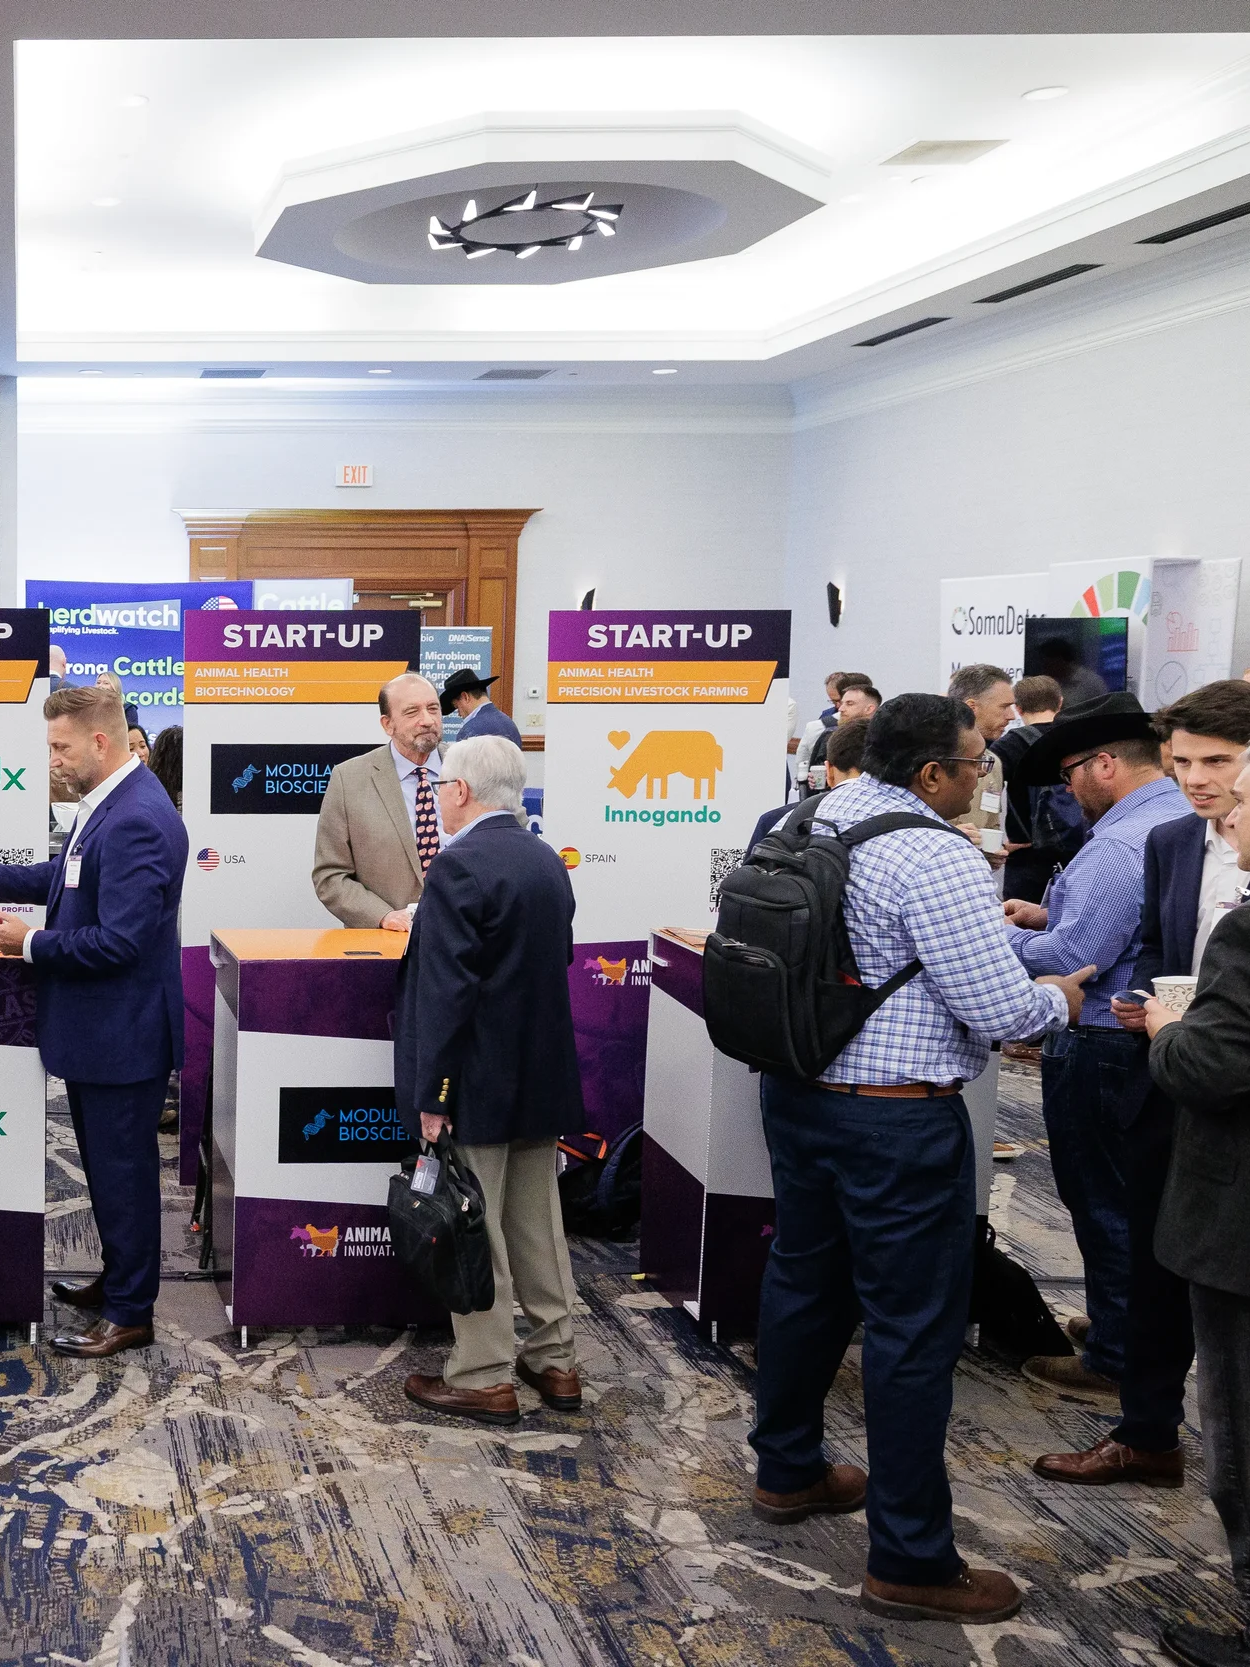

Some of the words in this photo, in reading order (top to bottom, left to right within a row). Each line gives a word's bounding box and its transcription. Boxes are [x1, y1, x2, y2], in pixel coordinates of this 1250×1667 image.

[343, 466, 368, 484] EXIT
[968, 605, 1042, 635] SomaDe
[223, 623, 384, 648] START-UP
[587, 623, 753, 648] START-UP
[425, 651, 481, 661] Microbiome
[113, 656, 184, 676] Cattle
[437, 661, 446, 670] in
[447, 661, 481, 670] Animal
[195, 668, 241, 678] ANIMAL
[243, 668, 288, 678] HEALTH
[558, 668, 604, 678] ANIMAL
[607, 667, 654, 678] HEALTH
[195, 686, 296, 697] BIOTECHNOLOGY
[558, 686, 621, 697] PRECISION
[624, 686, 690, 697] LIVESTOCK
[693, 686, 749, 697] FARMING
[604, 805, 721, 827] Innogando
[224, 855, 246, 864] USA
[585, 854, 617, 863] SPAIN
[344, 1245, 395, 1257] INNOVAT
